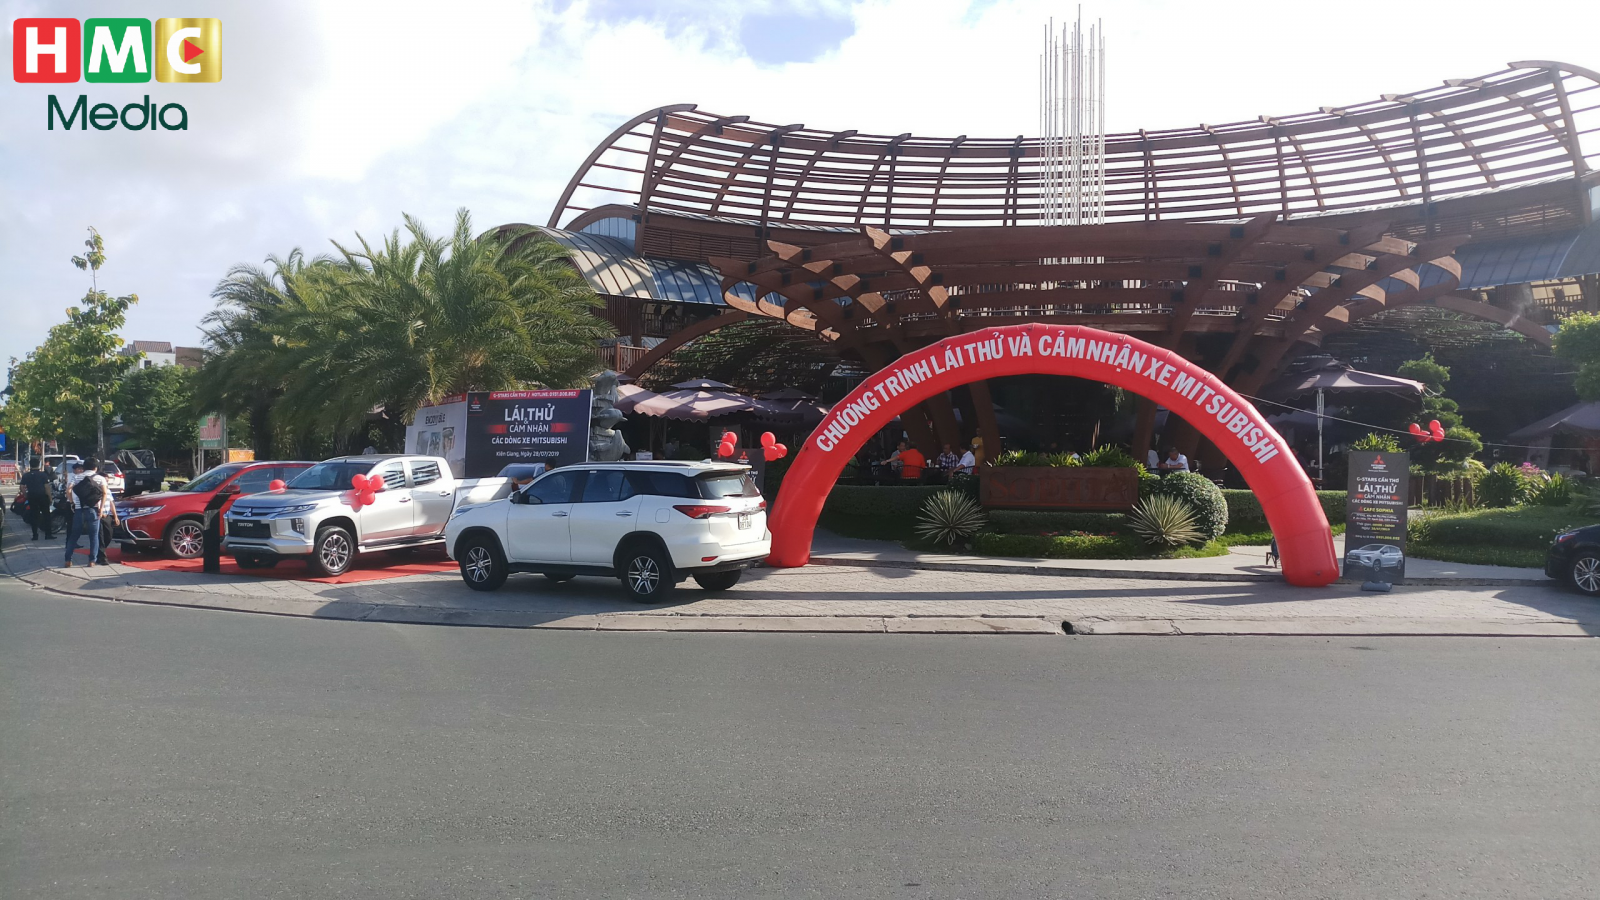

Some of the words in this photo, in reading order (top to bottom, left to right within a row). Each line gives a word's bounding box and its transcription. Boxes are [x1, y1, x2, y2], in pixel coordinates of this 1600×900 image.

[816, 391, 881, 452] CHƯƠNG
[873, 359, 932, 402] TRÌNH
[930, 345, 965, 375] LÁI
[964, 332, 1004, 364] THỬ
[1008, 331, 1033, 357] VÀ
[1038, 330, 1085, 359] CẢM
[1086, 343, 1148, 374] NHẬN
[1142, 358, 1177, 387] XE
[1170, 371, 1279, 464] MITSUBISHI
[504, 405, 524, 421] LÁI
[527, 403, 555, 421] THỬ
[510, 422, 525, 432] CẢM
[527, 422, 548, 434] NHẬN
[492, 436, 503, 444] CÁC
[1358, 483, 1373, 492] LÁI
[1375, 483, 1397, 493] THỬ
